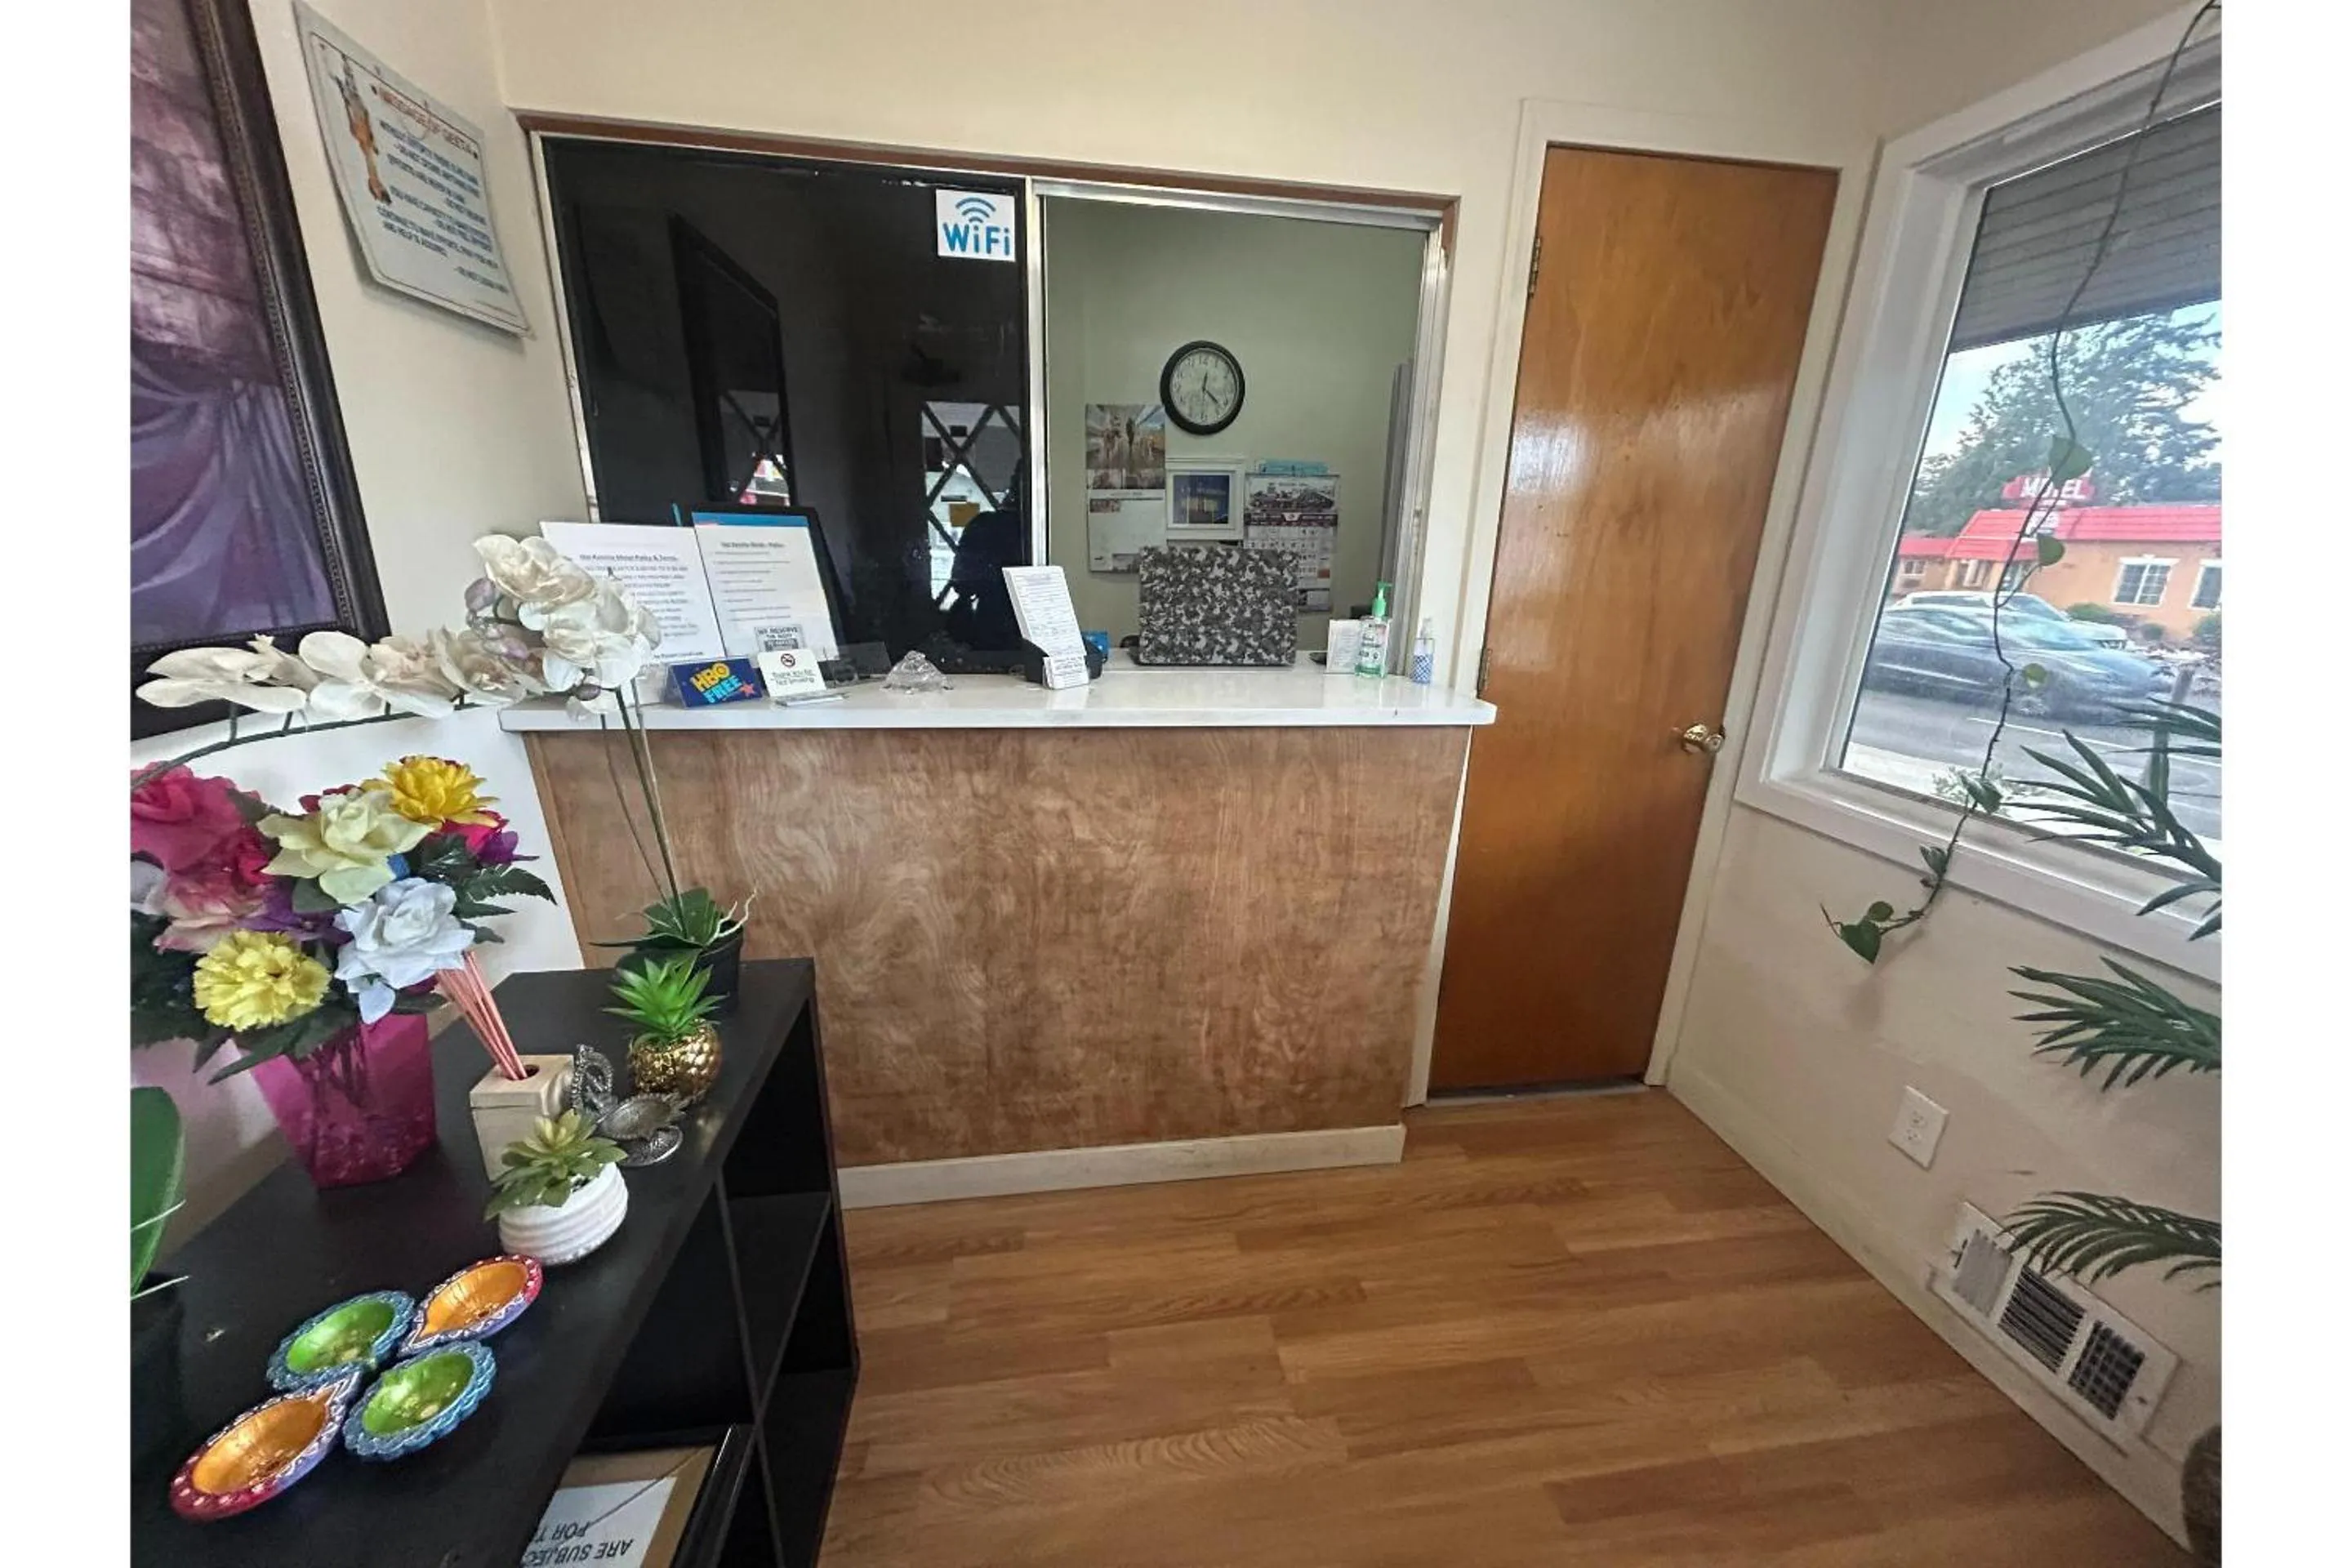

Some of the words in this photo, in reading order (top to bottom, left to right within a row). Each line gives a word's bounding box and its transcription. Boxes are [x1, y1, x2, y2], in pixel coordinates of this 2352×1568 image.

[942, 221, 1010, 256] WiFi
[690, 662, 730, 692] HBO
[702, 675, 742, 703] FREE
[522, 1544, 592, 1567] SUBJEC
[594, 1539, 634, 1559] ARE
